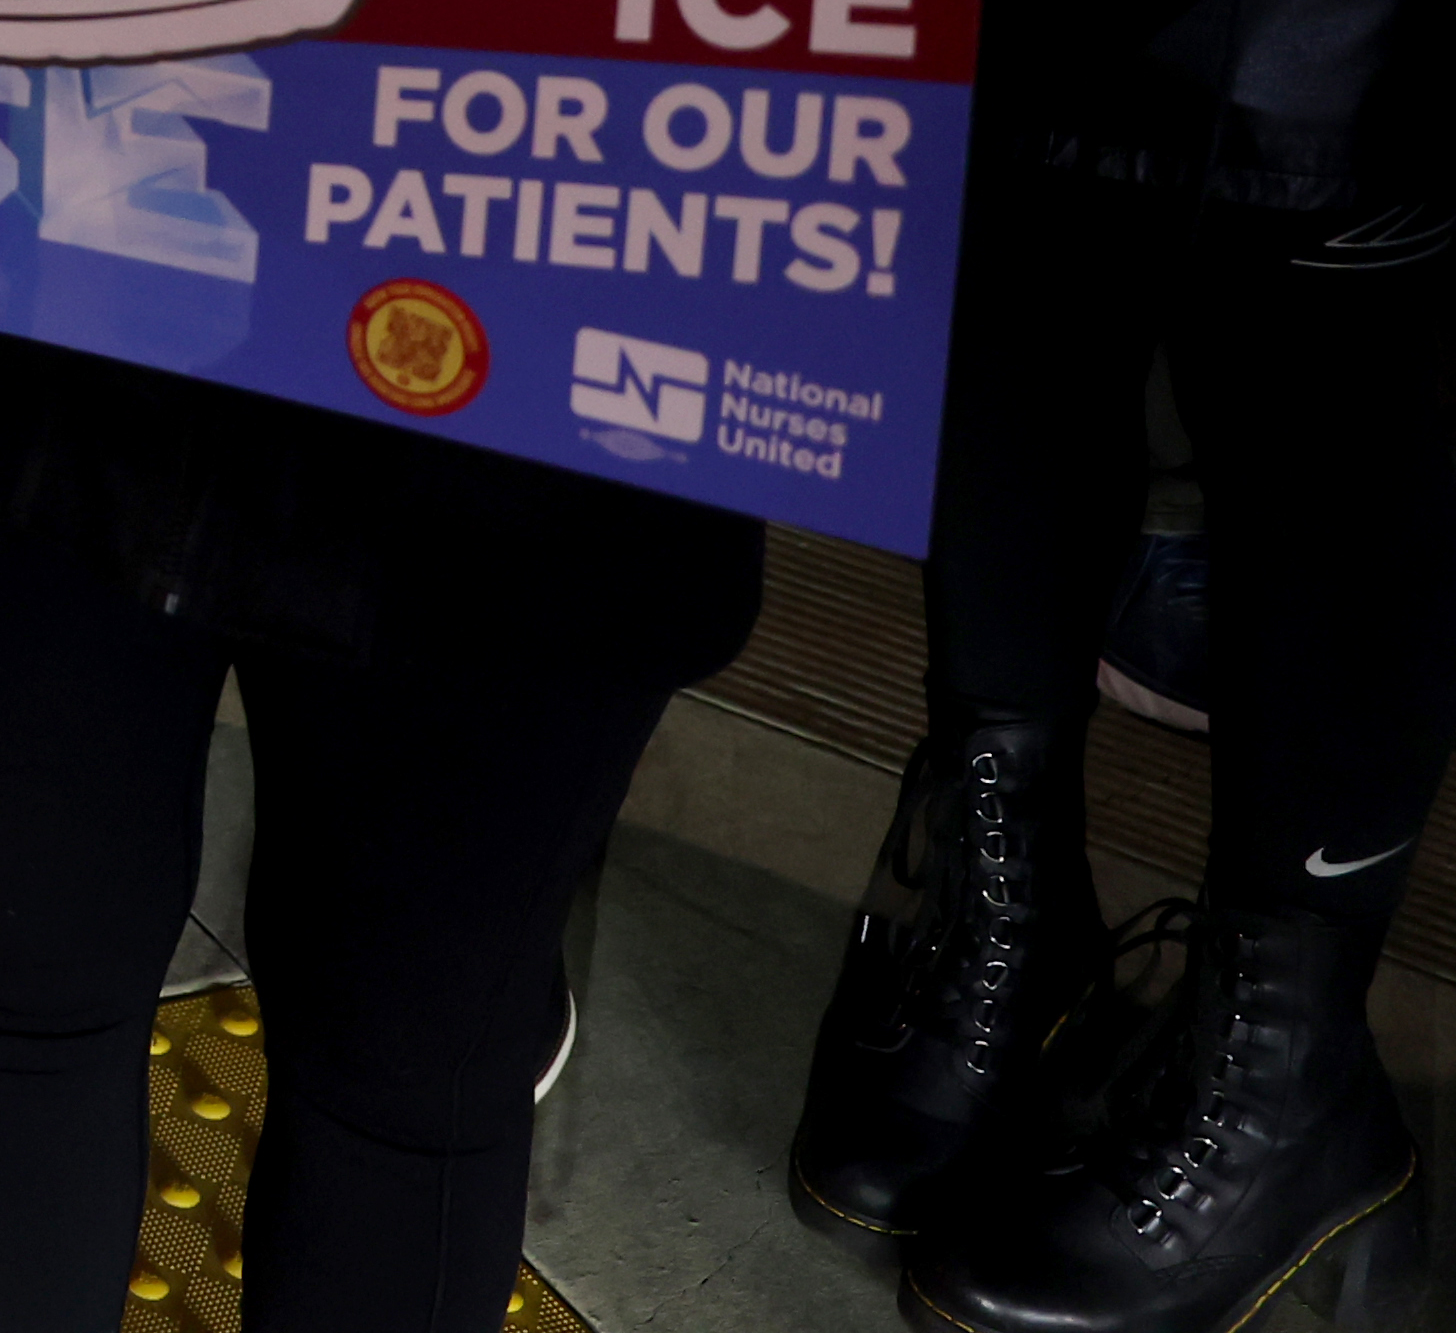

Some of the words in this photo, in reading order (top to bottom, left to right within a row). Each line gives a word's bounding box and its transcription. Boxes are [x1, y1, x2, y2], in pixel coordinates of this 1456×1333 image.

[371, 65, 608, 163] FOR
[642, 82, 912, 190] OUR
[302, 162, 902, 299] PATIENTS!
[720, 391, 849, 448] Nurses
[723, 359, 884, 422] National
[717, 424, 844, 481] United
